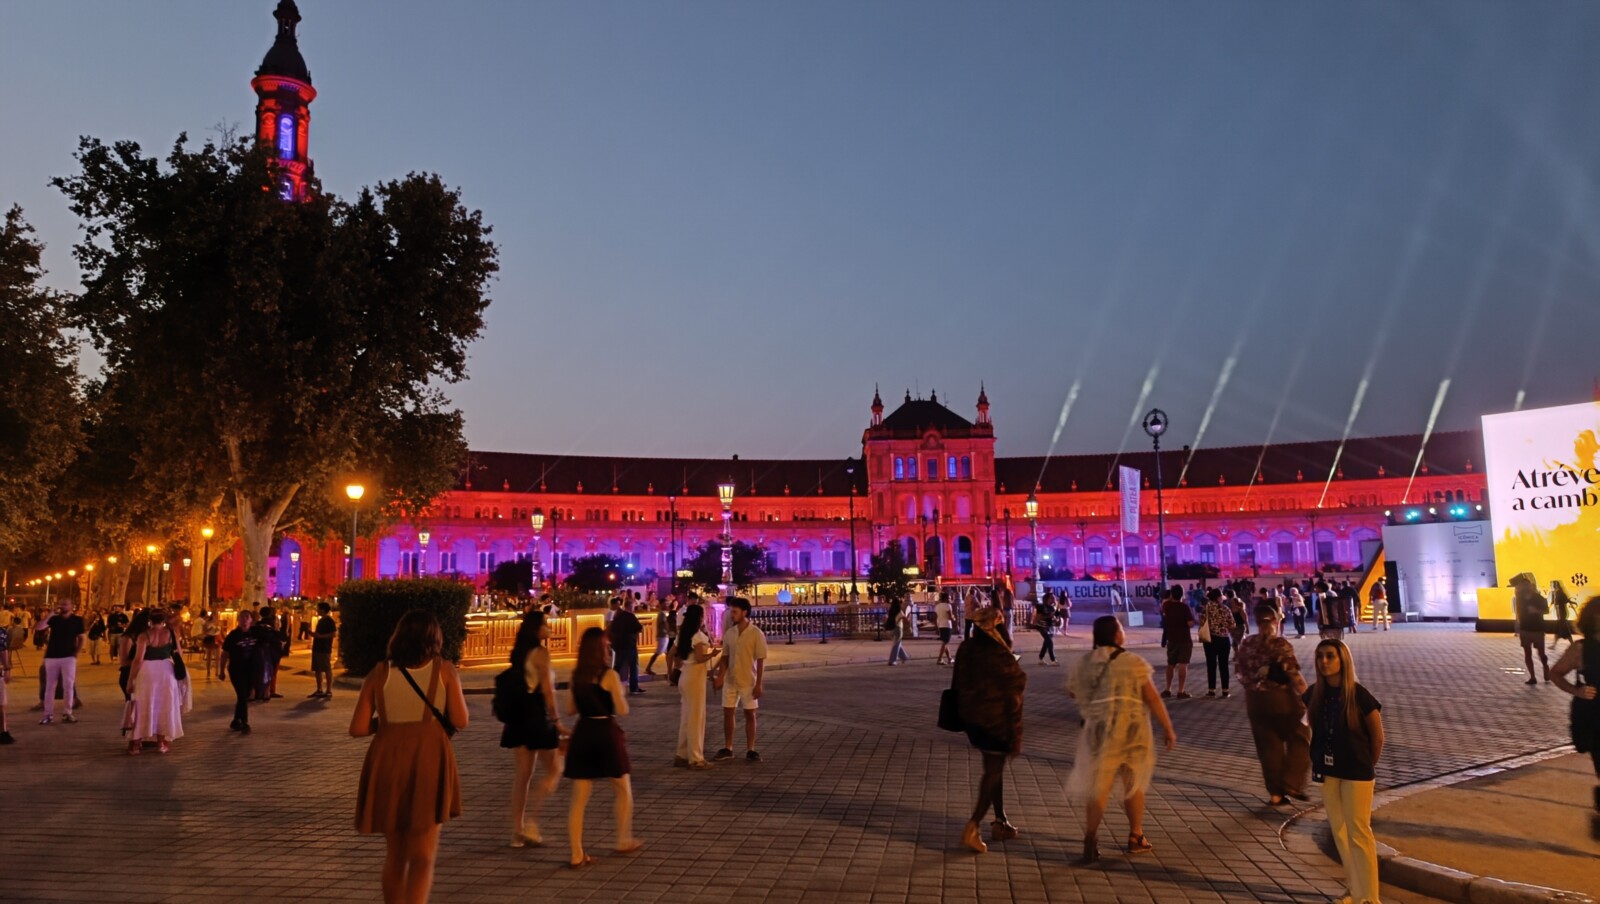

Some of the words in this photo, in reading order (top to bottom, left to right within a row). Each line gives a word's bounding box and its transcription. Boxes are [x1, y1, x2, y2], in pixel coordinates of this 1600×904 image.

[1512, 464, 1600, 490] Atréve
[1512, 497, 1525, 511] a
[1530, 488, 1600, 510] camb
